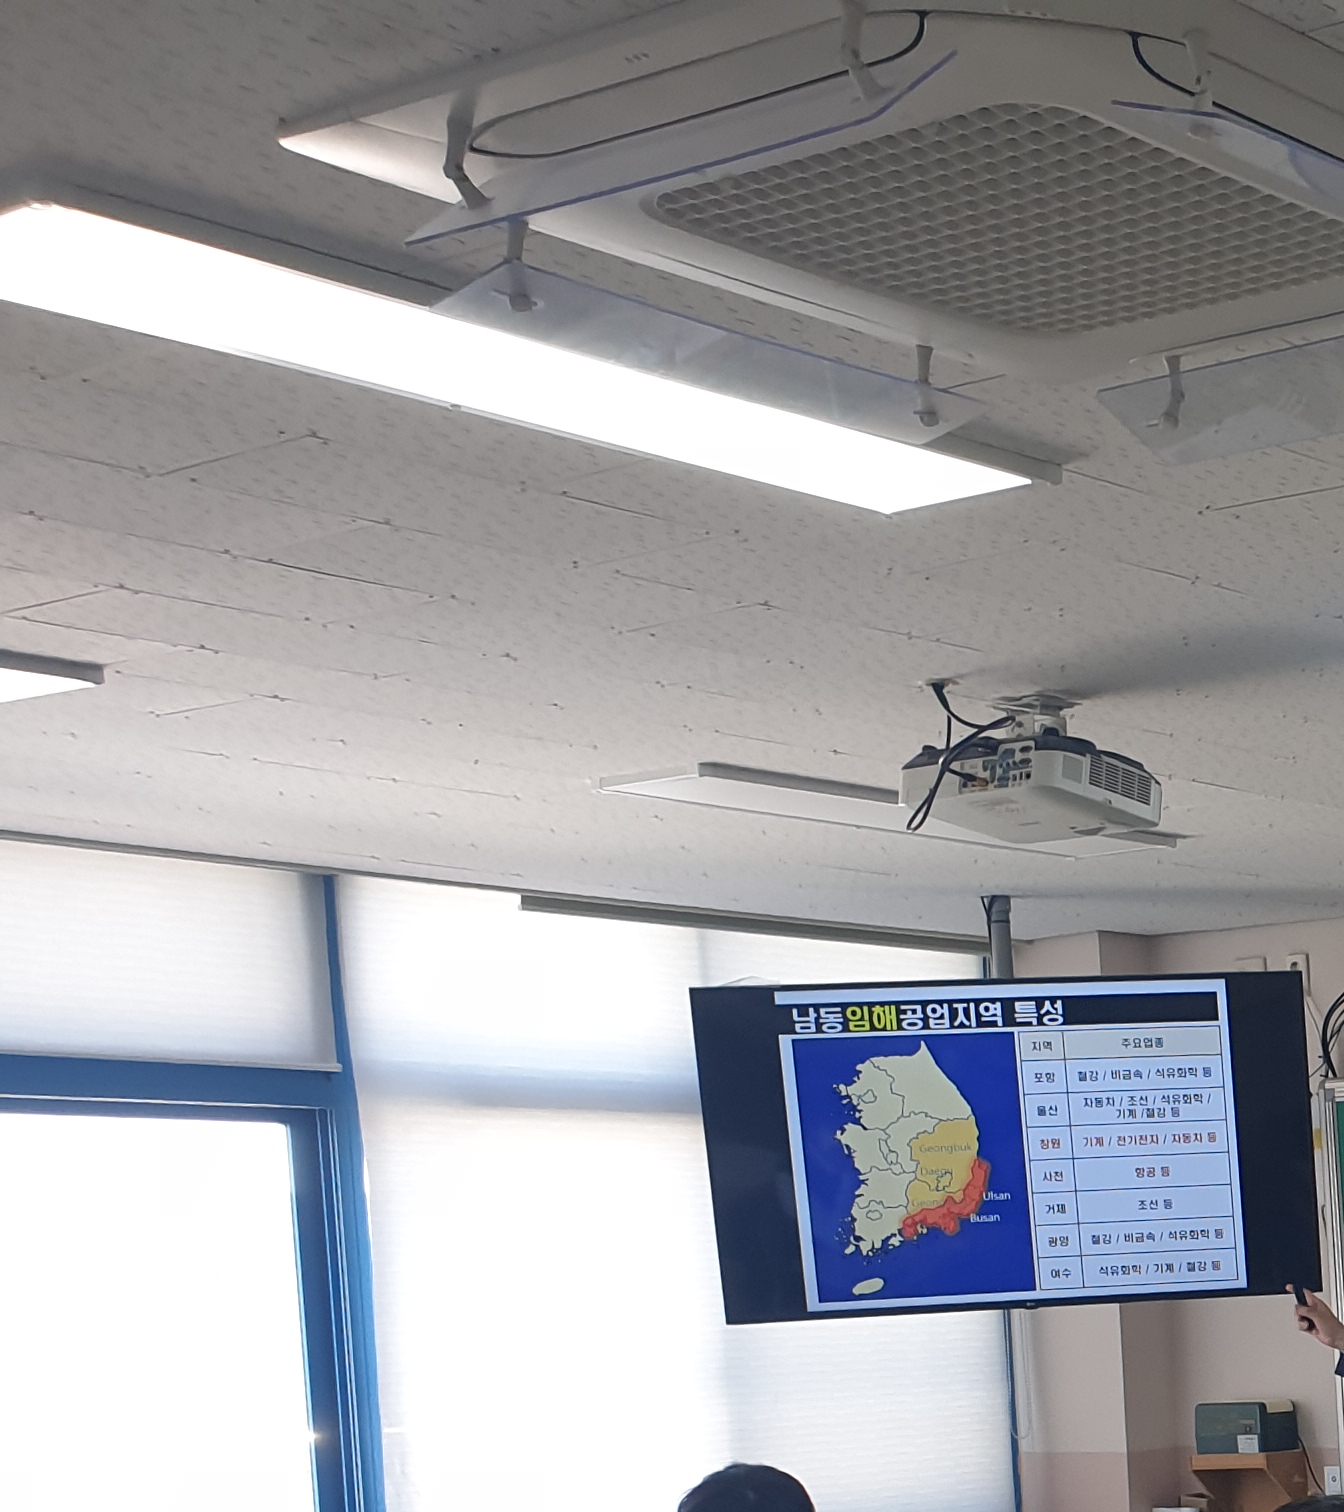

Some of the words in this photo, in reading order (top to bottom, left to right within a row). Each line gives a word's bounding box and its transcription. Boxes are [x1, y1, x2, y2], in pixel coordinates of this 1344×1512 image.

[792, 1001, 1004, 1034] 남동임해공업지역
[1013, 999, 1065, 1026] 특성
[1031, 1041, 1053, 1052] 지역
[1202, 1066, 1212, 1078] 등
[1034, 1072, 1055, 1084] 포항
[1207, 1132, 1217, 1143] 등
[1042, 1170, 1064, 1182] 사천
[1161, 1166, 1170, 1177] 등
[982, 1191, 1011, 1201] Ulsan
[1045, 1204, 1067, 1215] 거제
[1138, 1200, 1159, 1211] 조선
[1164, 1199, 1173, 1210] 등
[970, 1214, 1000, 1223] Busan
[1215, 1228, 1224, 1240] 등
[1211, 1260, 1221, 1271] 등
[1051, 1268, 1072, 1279] 여수
